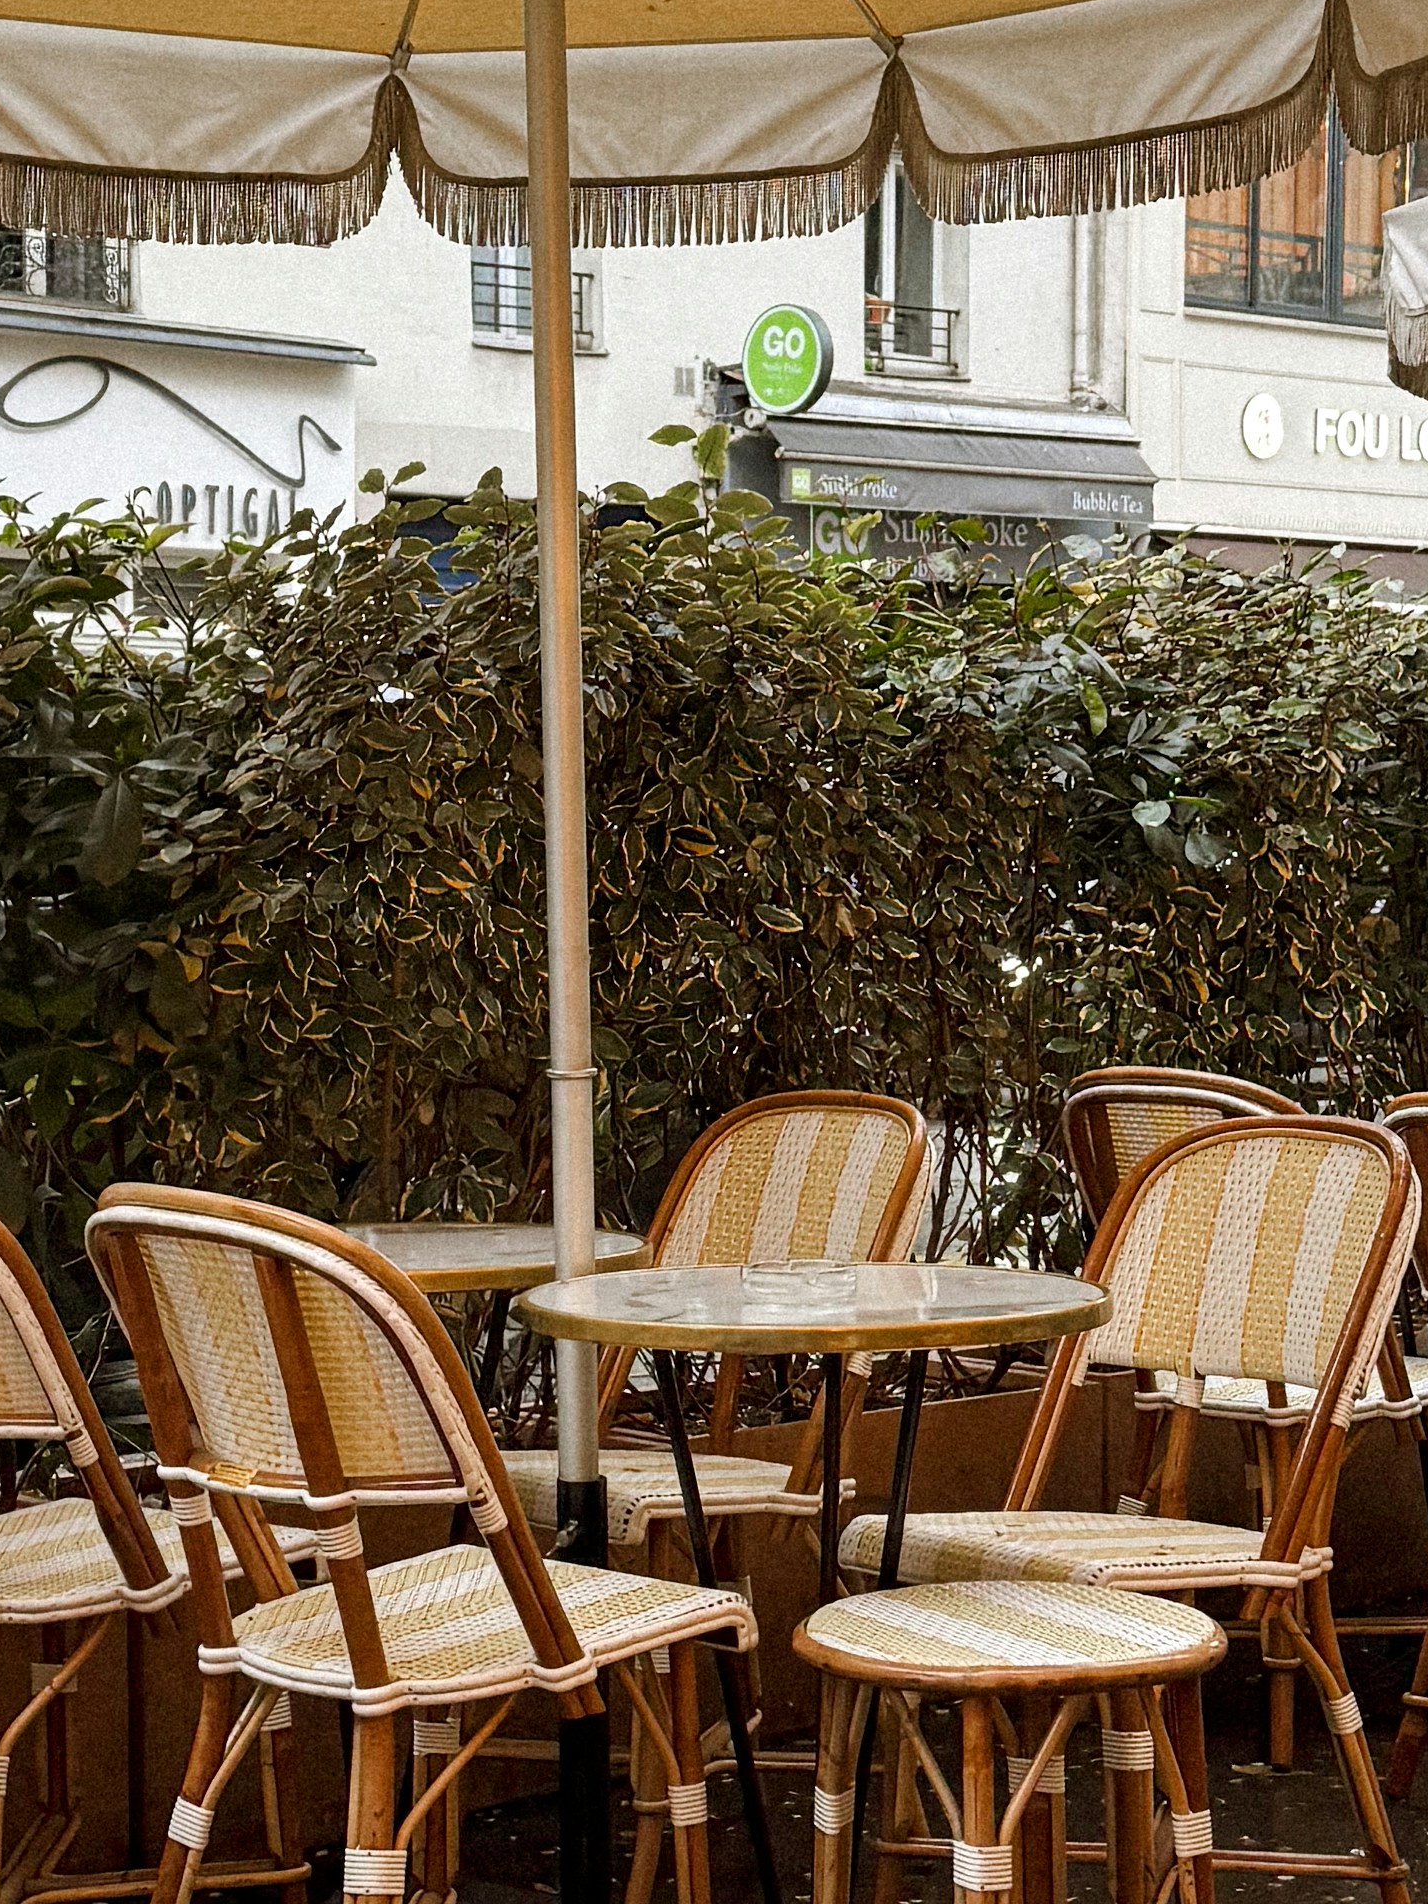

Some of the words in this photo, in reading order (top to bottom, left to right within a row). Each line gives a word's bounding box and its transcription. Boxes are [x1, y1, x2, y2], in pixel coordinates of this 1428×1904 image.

[762, 325, 806, 360] GO
[1314, 407, 1389, 459] FOU
[1072, 490, 1119, 512] Bubble
[1120, 494, 1144, 514] Tea
